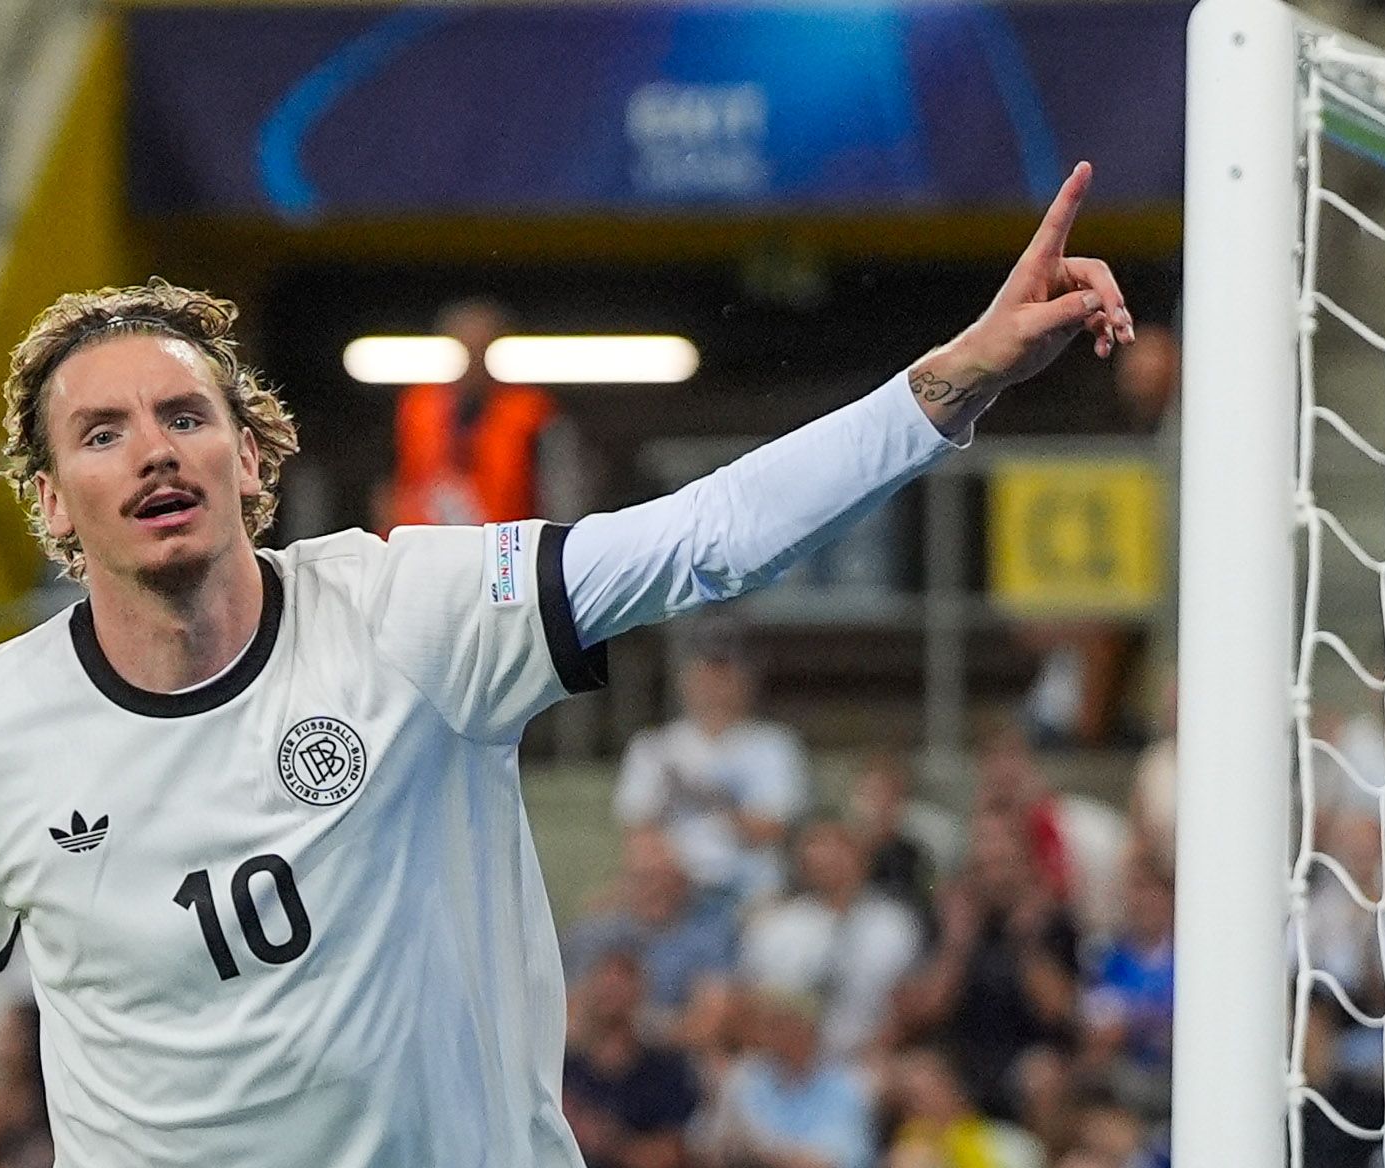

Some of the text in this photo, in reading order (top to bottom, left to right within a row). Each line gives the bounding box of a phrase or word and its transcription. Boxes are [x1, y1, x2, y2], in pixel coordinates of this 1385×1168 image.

[499, 526, 512, 601] FOUNDATION
[281, 739, 320, 800] DEUTSCHER
[172, 854, 312, 981] 10
